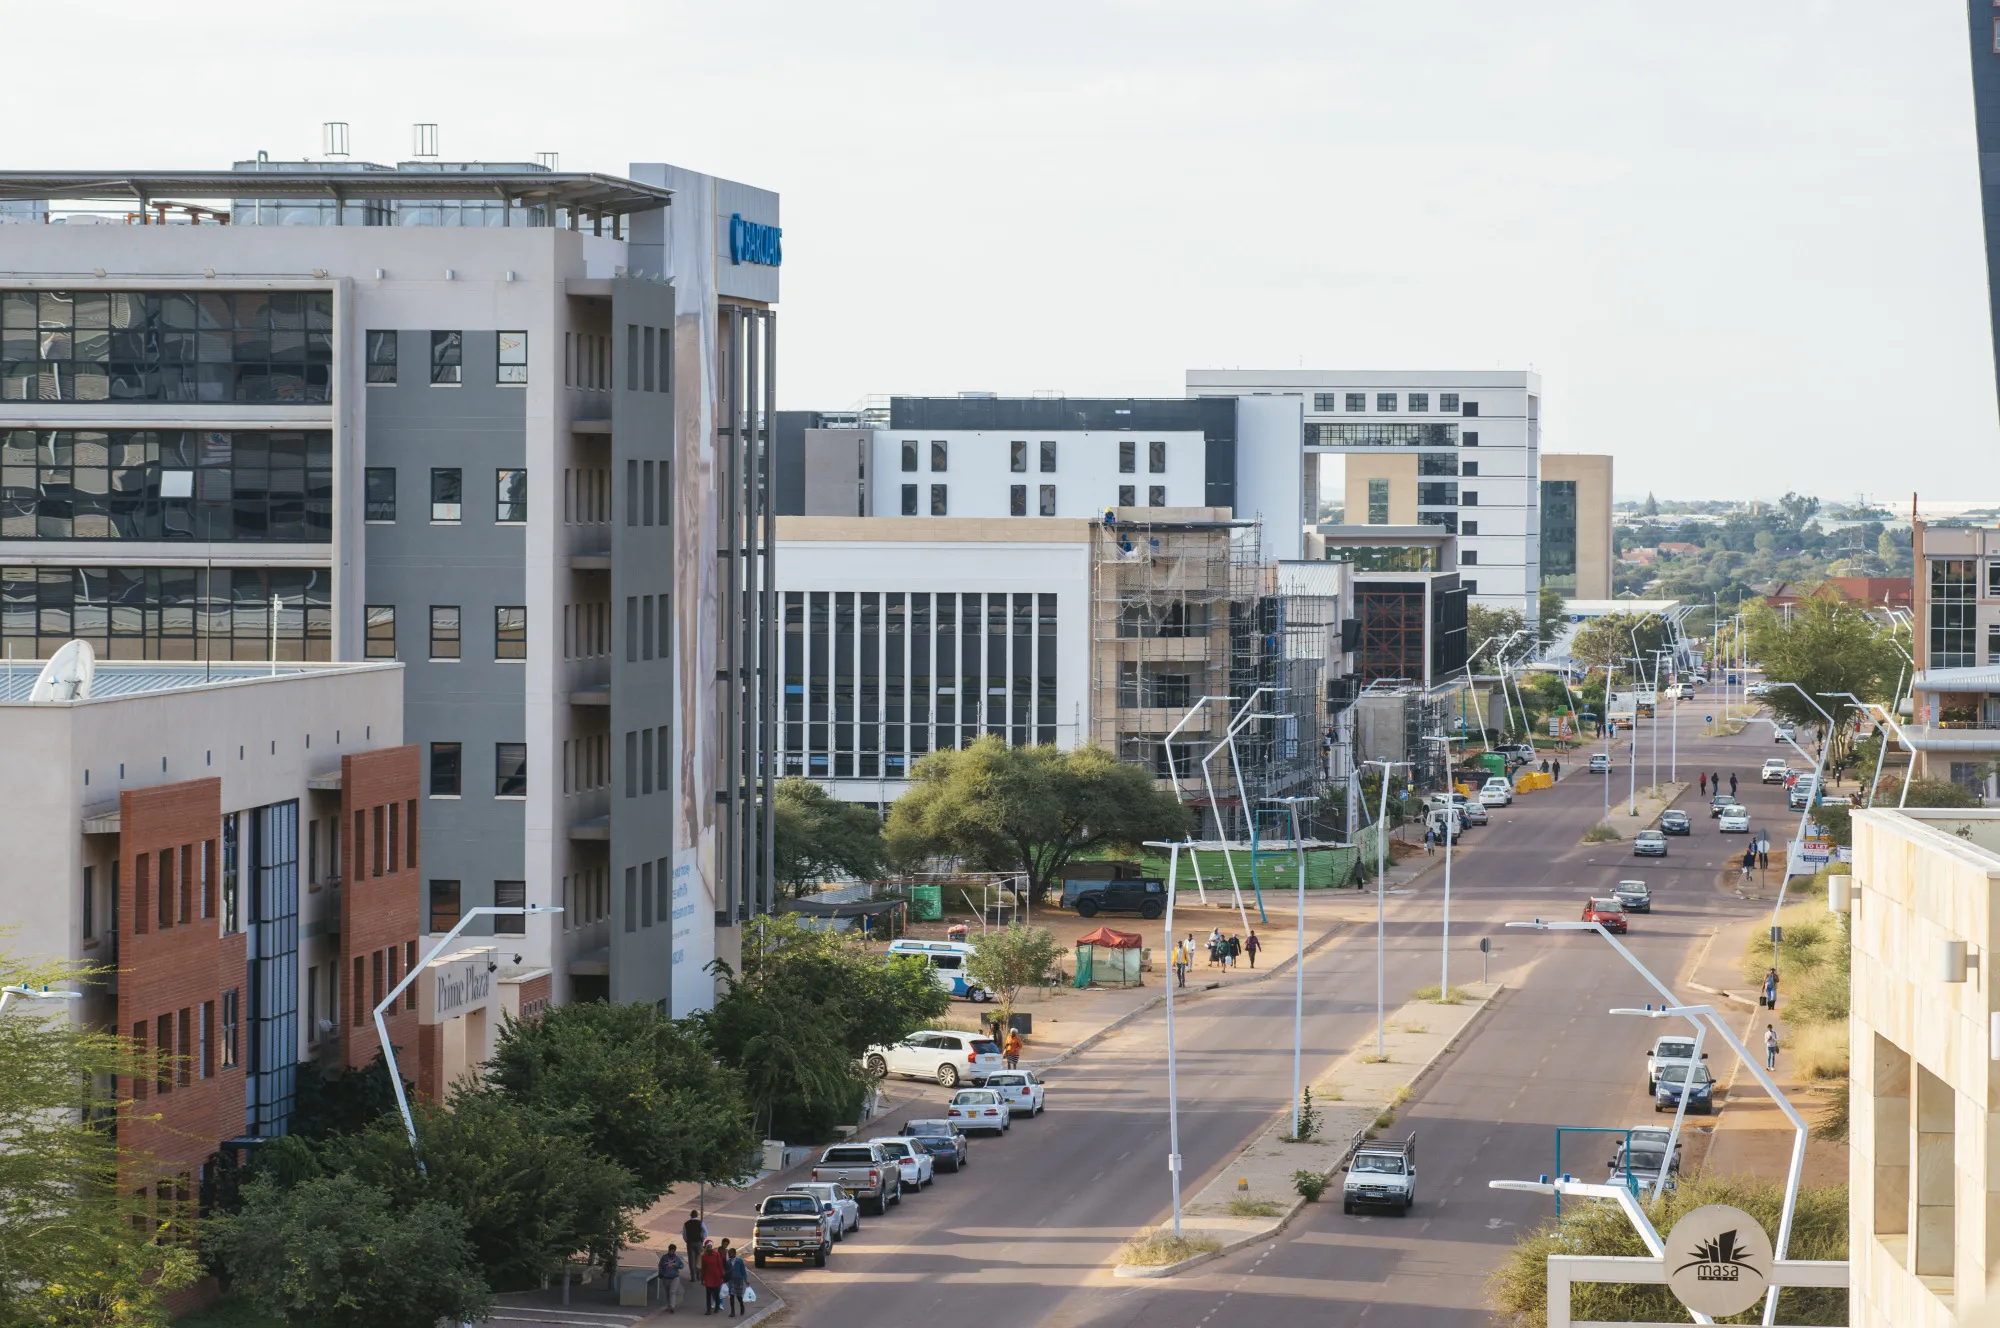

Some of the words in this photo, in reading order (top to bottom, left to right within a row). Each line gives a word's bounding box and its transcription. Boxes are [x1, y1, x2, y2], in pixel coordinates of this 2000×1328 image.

[742, 220, 782, 267] BARCLAYS
[437, 974, 464, 1013] Prime
[465, 965, 489, 1003] Plaza
[1698, 1264, 1739, 1277] masa
